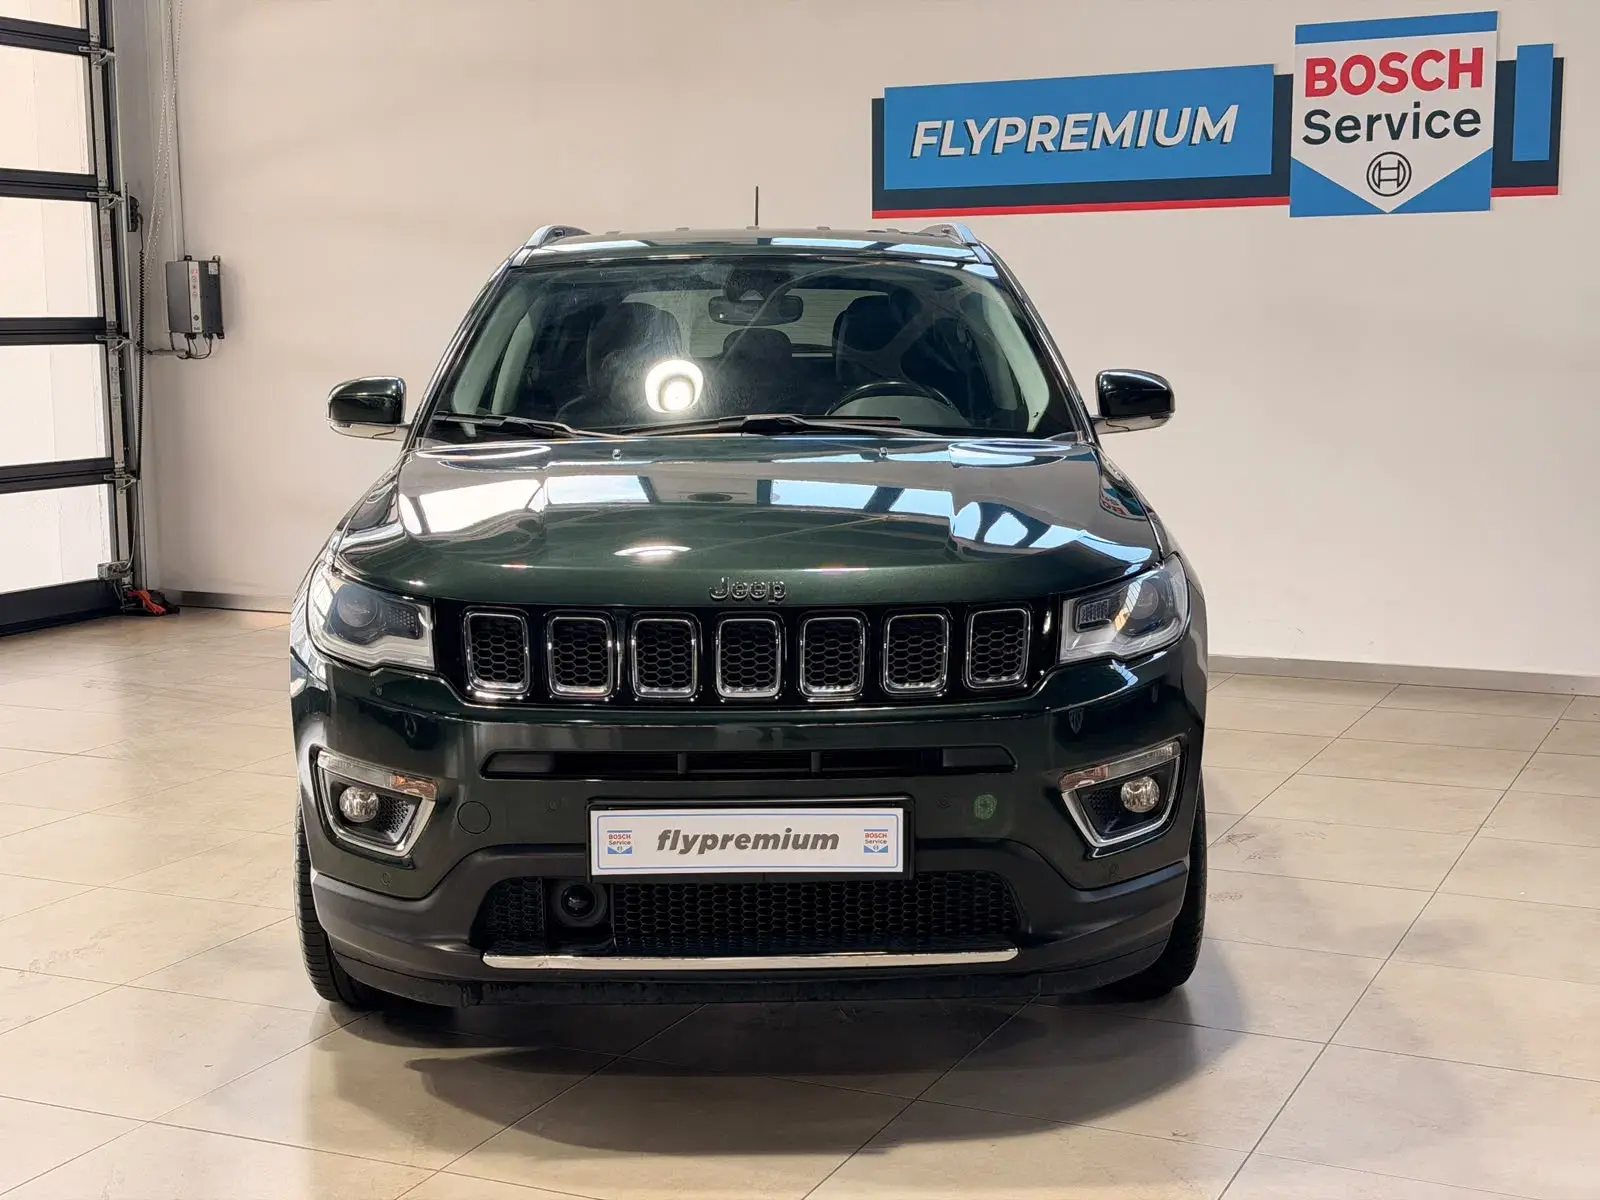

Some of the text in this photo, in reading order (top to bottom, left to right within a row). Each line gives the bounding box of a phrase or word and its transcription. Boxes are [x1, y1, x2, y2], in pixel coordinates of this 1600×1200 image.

[1305, 47, 1483, 97] BOSCH
[911, 104, 1239, 158] FLYPREMIUM
[1302, 101, 1481, 145] Service
[709, 577, 786, 604] Jeep
[656, 827, 840, 855] flypremium
